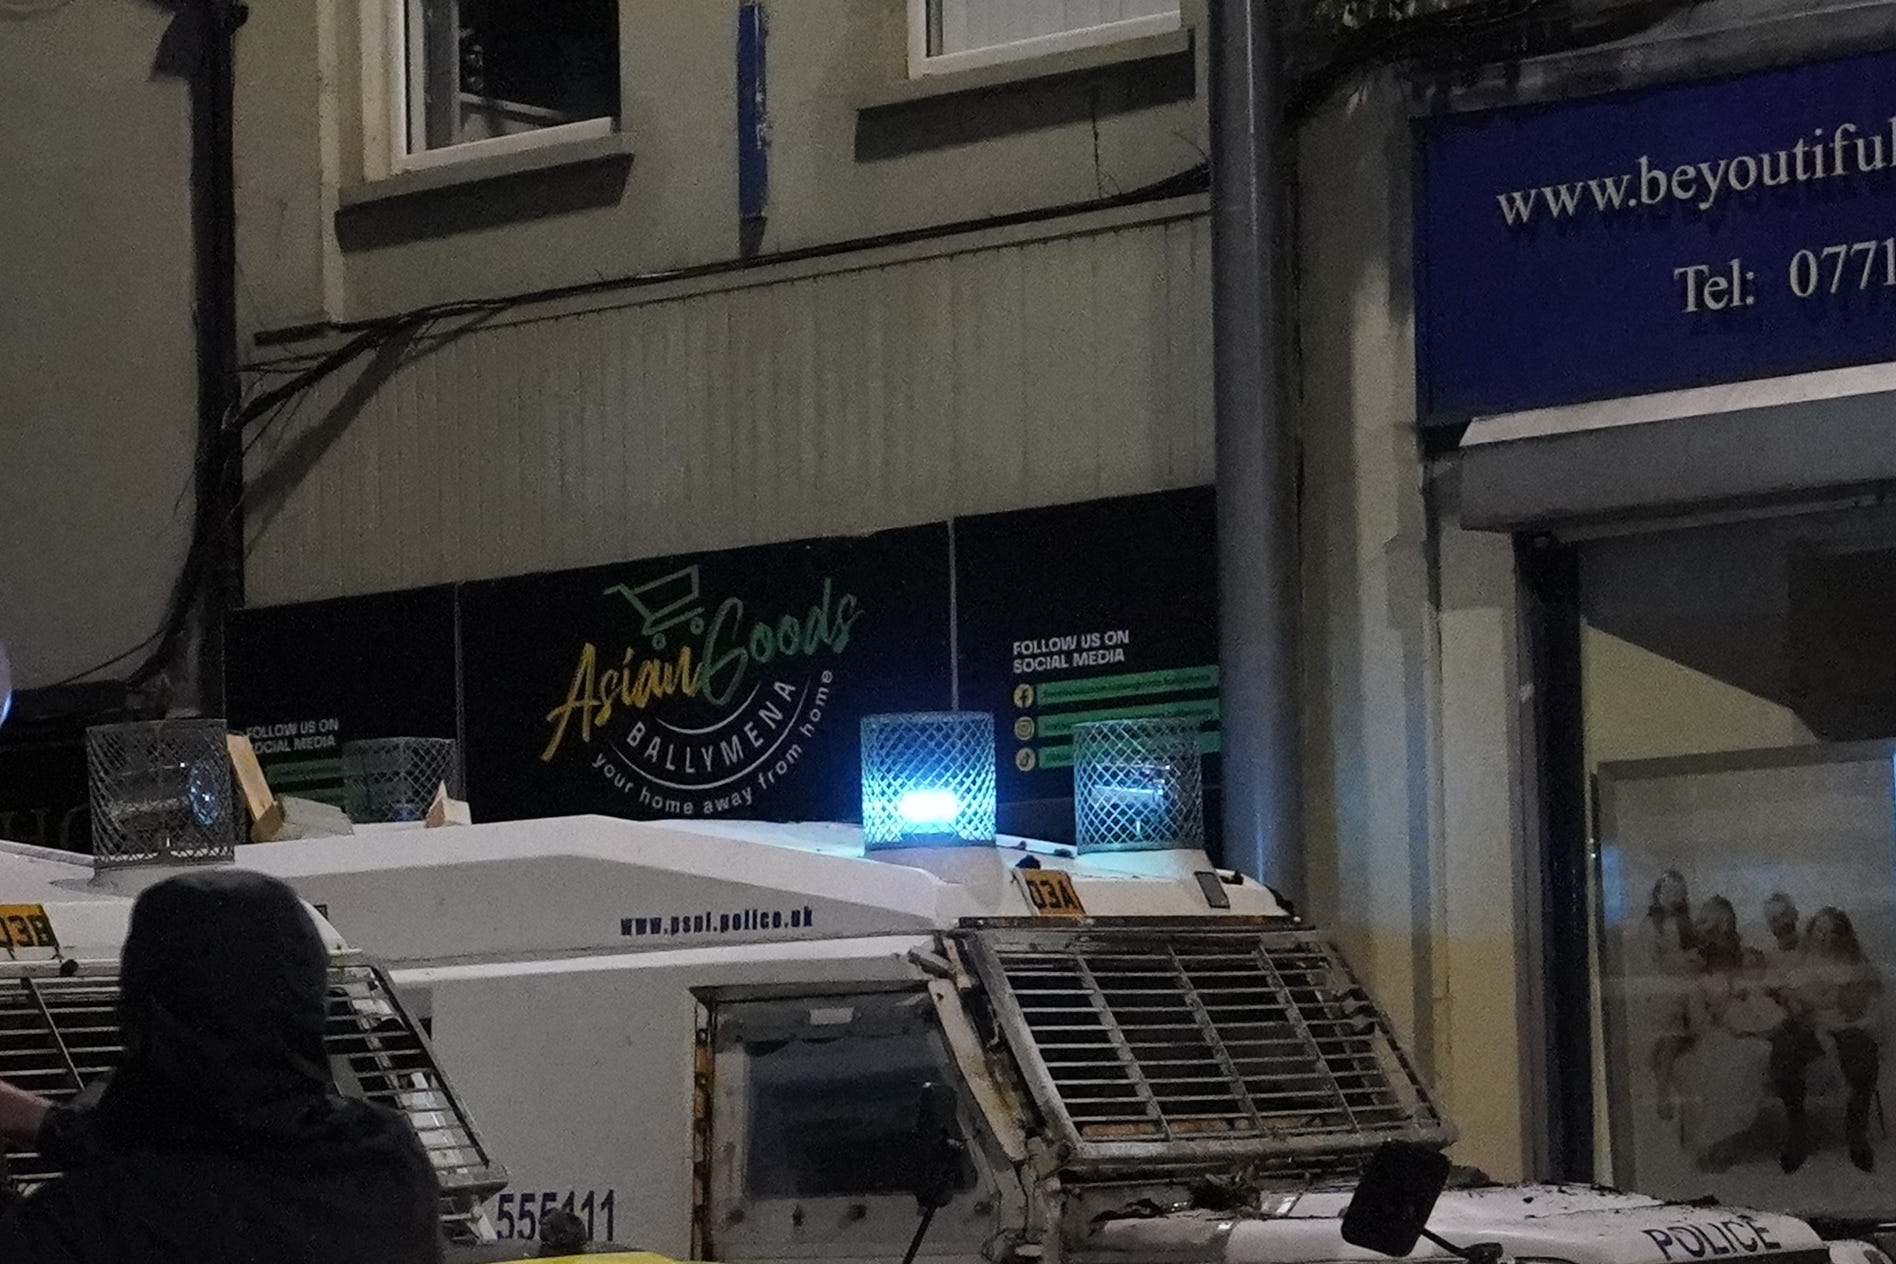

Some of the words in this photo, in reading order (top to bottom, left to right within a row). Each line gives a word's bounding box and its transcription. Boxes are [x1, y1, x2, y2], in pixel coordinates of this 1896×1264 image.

[1673, 257, 1756, 313] Tel:
[1789, 236, 1896, 298] 0771
[703, 577, 866, 706] Goods
[1012, 634, 1078, 657] FOLLOW
[1080, 631, 1101, 649] US
[1104, 629, 1130, 646] ON
[1012, 656, 1070, 674] SOCIAL
[1072, 648, 1125, 668] MEDIA
[539, 641, 704, 762] Asian
[247, 724, 298, 738] FOLLOW
[301, 721, 316, 734] US
[319, 719, 339, 731] ON
[255, 741, 291, 754] OCIAL
[294, 736, 336, 750] MEDIA
[591, 751, 635, 793] your
[640, 785, 694, 815] home
[703, 785, 753, 815] away
[757, 743, 804, 791] from
[799, 668, 834, 738] home
[625, 679, 797, 775] BALLYMENA
[620, 905, 813, 936] www.psni.police.uk
[1643, 1215, 1782, 1261] POLICE
